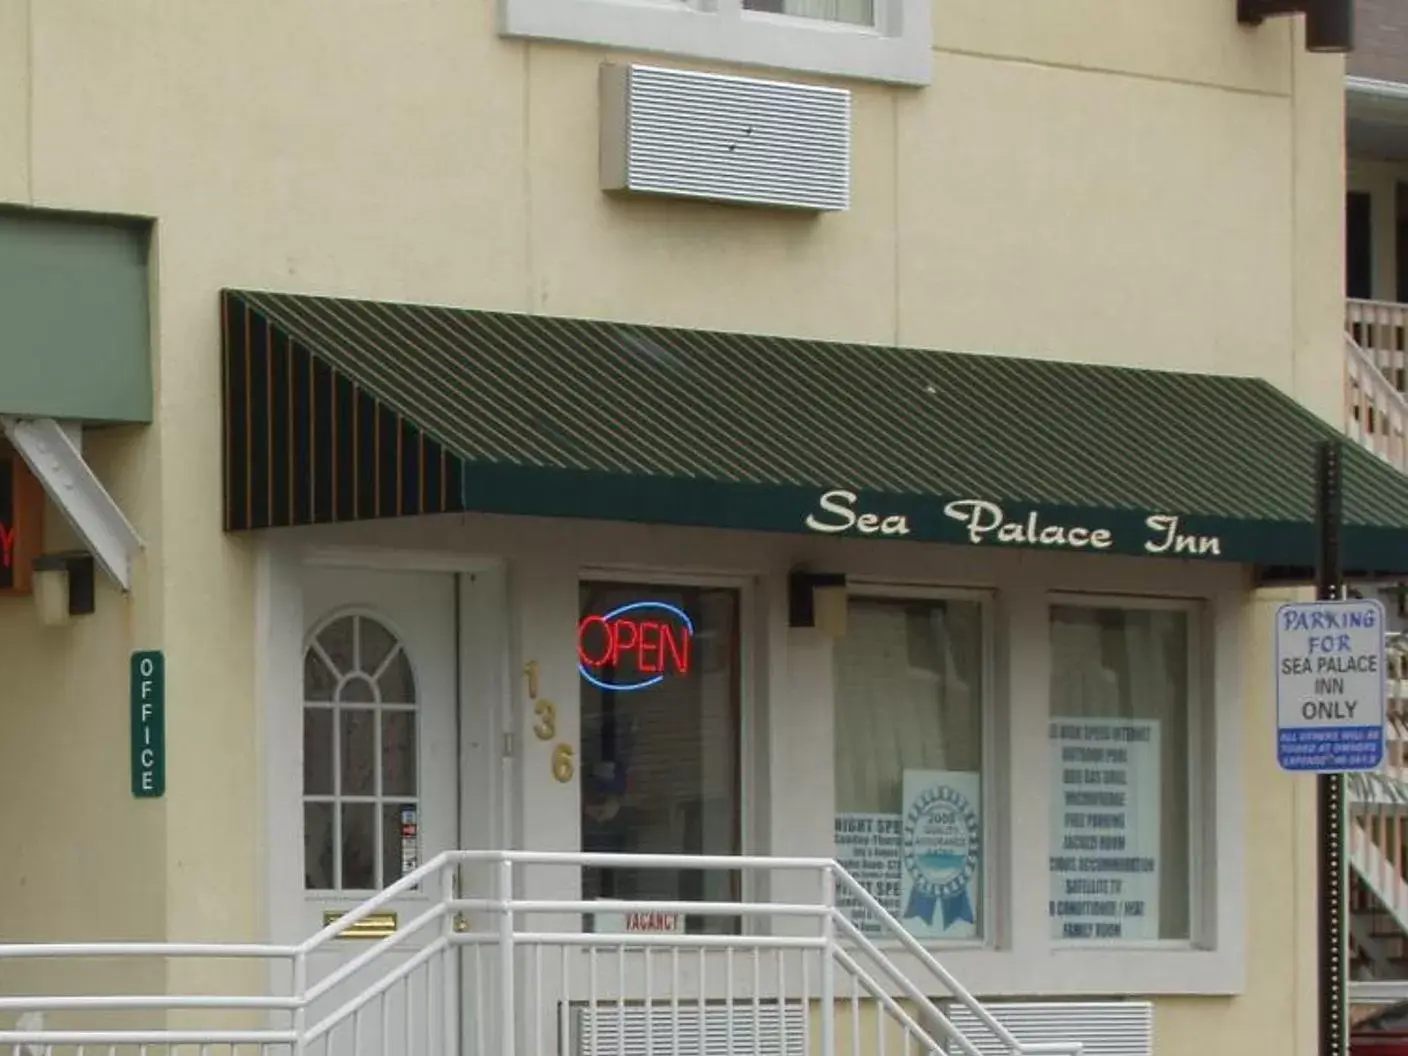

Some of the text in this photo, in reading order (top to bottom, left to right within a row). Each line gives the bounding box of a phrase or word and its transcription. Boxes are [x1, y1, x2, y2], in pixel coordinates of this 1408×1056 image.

[806, 490, 1221, 555] Sea Palace Inn
[1282, 609, 1376, 631] PARKING
[578, 615, 690, 673] OPEN
[1308, 635, 1352, 653] FOR
[1282, 655, 1377, 675] SEA PALACE
[1315, 678, 1344, 695] INN
[1302, 700, 1357, 720] ONLY
[140, 658, 154, 790] OFFICE
